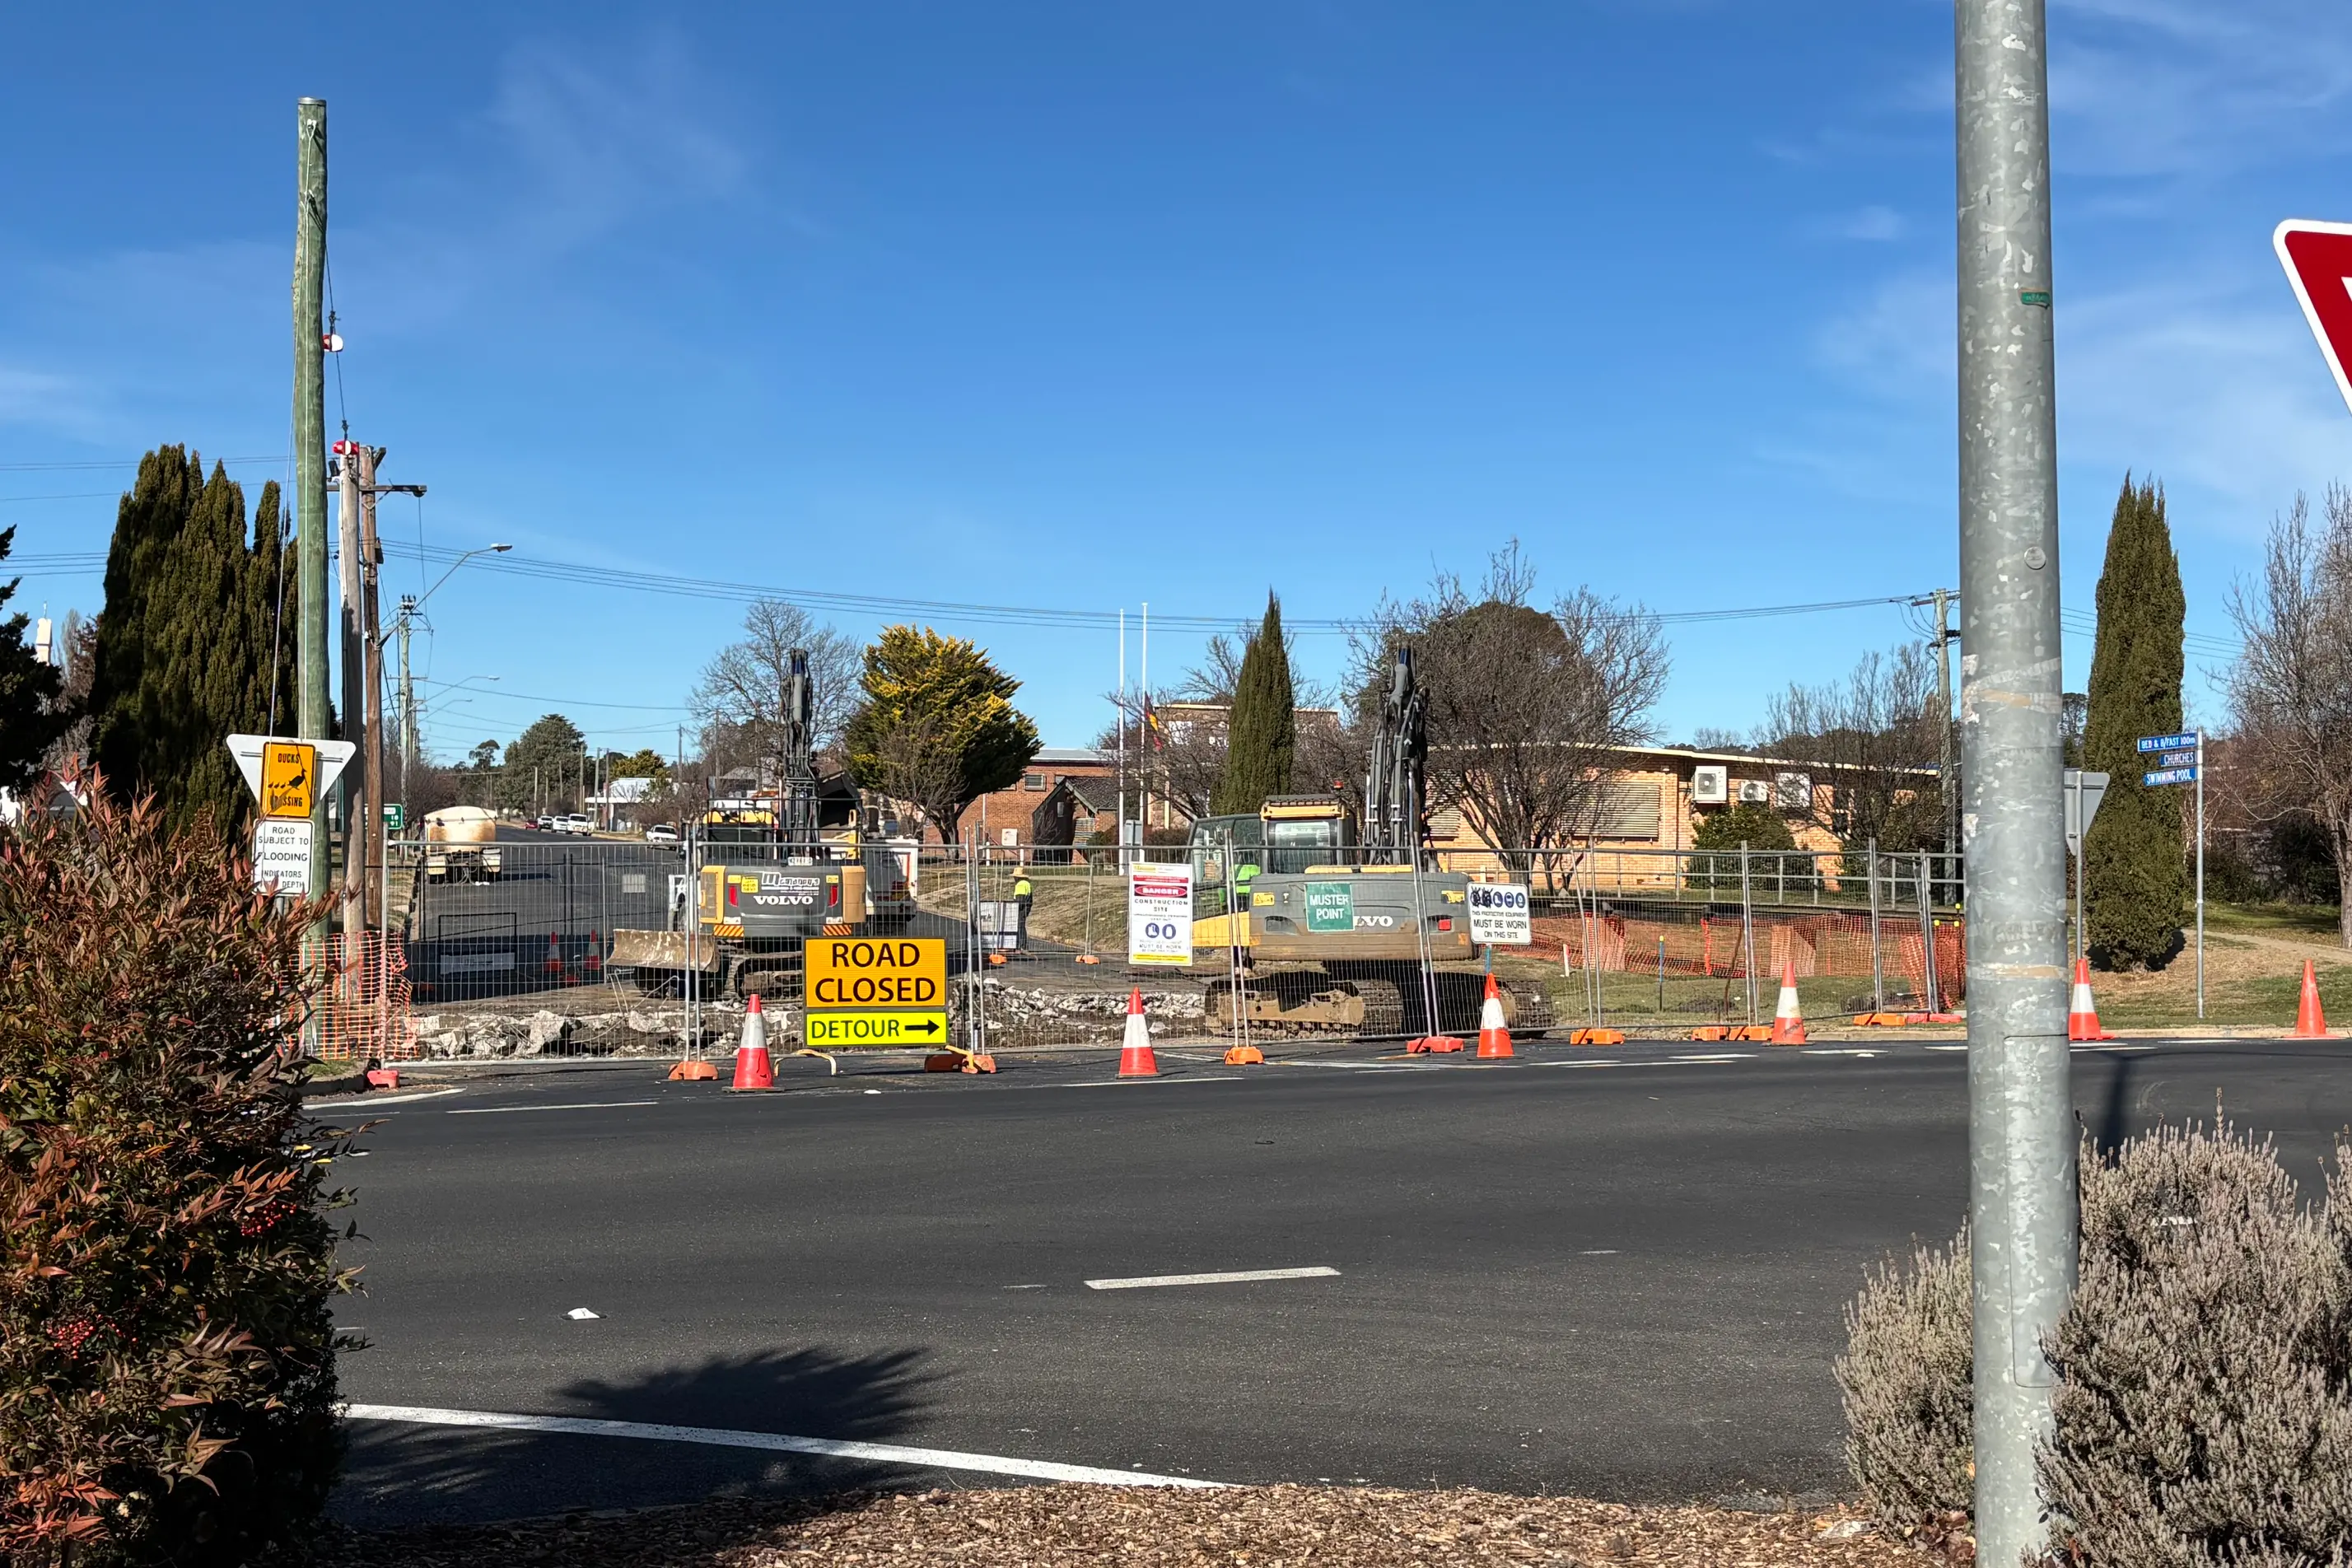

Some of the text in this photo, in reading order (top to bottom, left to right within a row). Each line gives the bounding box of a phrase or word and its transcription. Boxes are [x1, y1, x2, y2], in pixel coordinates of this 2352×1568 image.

[2141, 740, 2153, 749] BED
[2154, 740, 2159, 748] &
[278, 753, 300, 763] DUCKS
[2163, 752, 2194, 765] CHURCHES
[2146, 768, 2191, 785] SWIMMING POOL
[258, 836, 295, 844] SUBJECT
[753, 895, 814, 905] VOLVO
[1309, 894, 1349, 906] MUSTER
[1316, 908, 1345, 920] POINT
[1353, 916, 1393, 927] LVO
[1473, 919, 1528, 929] MUST BE WORN
[832, 943, 921, 968] ROAD
[814, 978, 936, 1002] CLOSED
[811, 1020, 900, 1038] DETOUR
